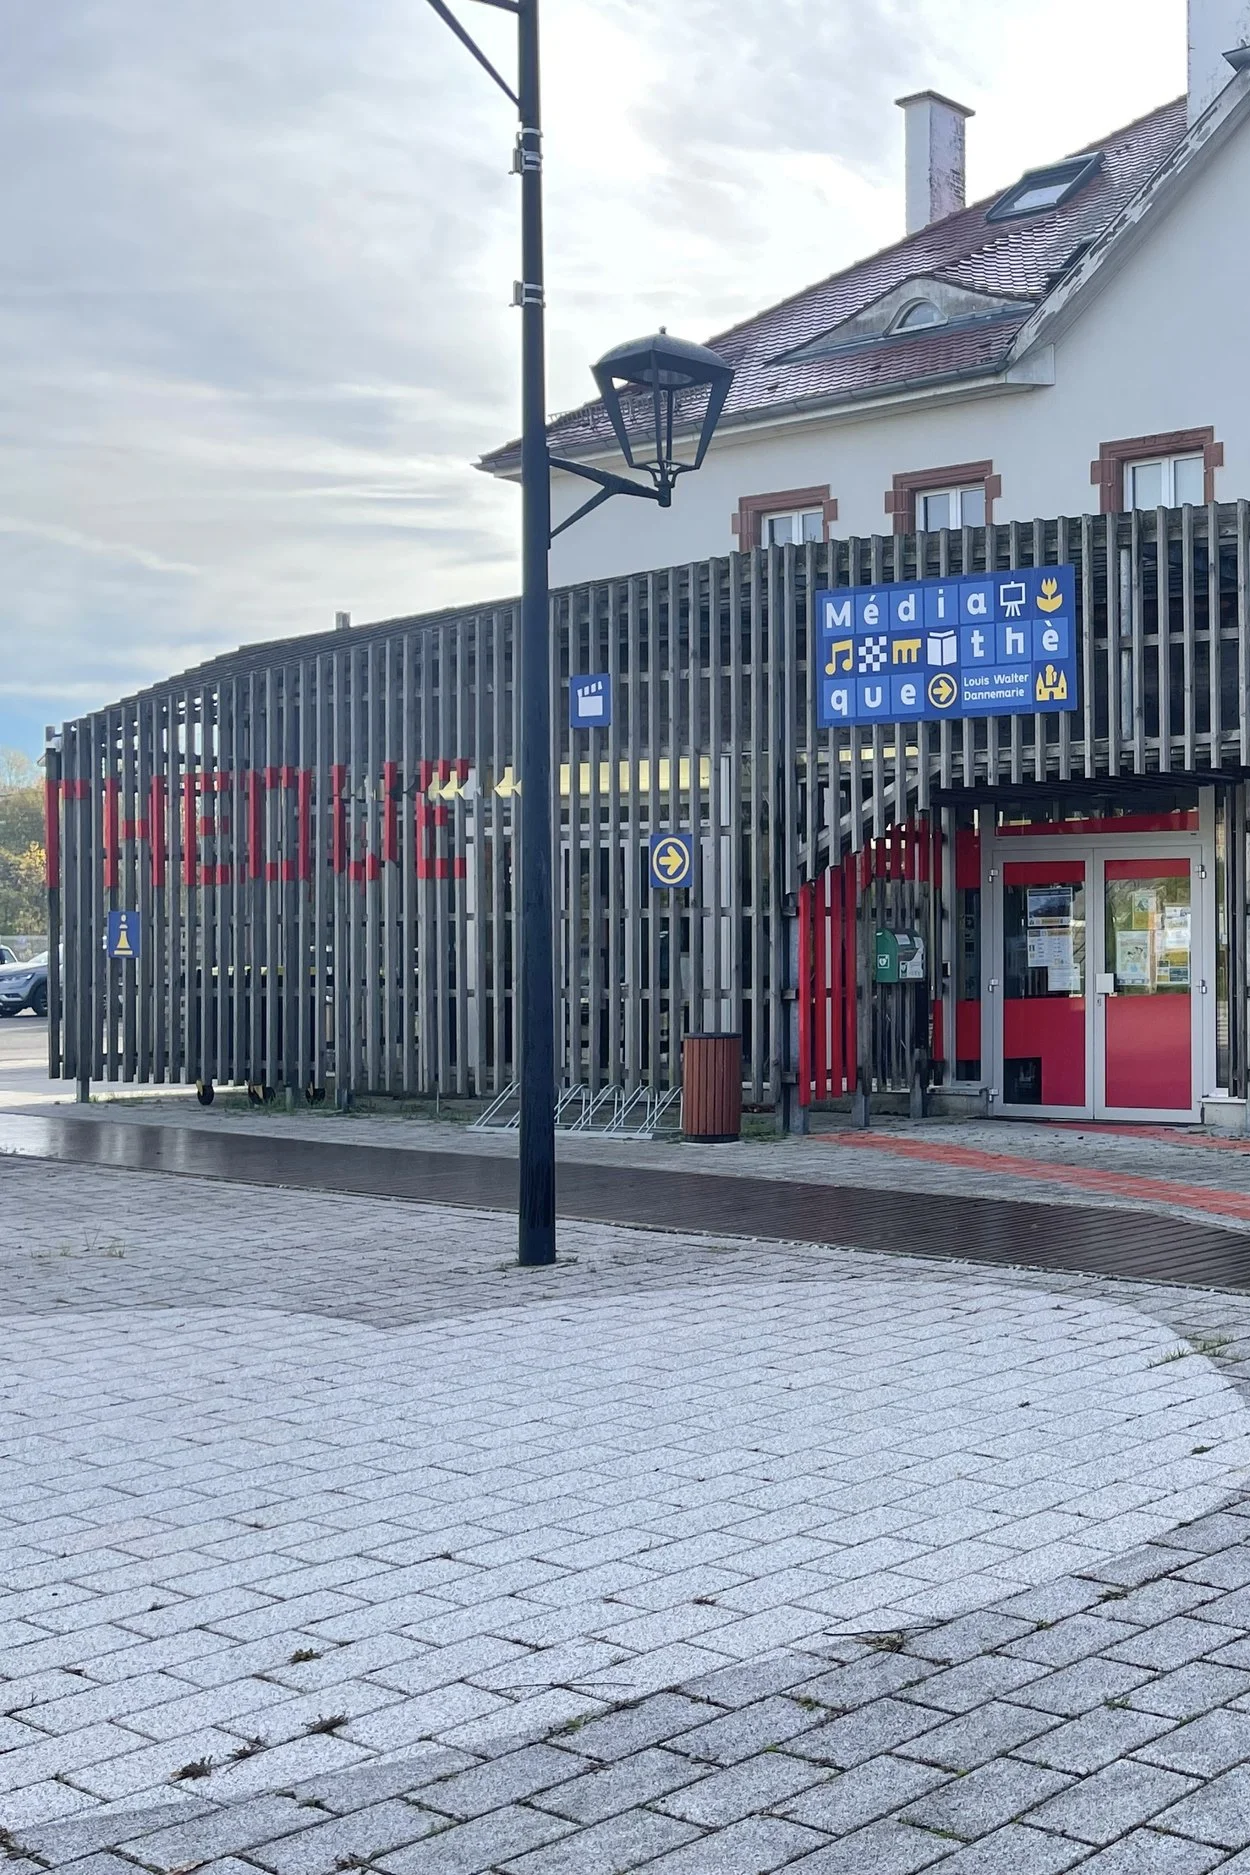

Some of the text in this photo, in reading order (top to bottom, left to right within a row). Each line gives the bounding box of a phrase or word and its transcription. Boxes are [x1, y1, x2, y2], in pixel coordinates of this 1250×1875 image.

[826, 588, 987, 629] Média
[970, 620, 1059, 658] thè
[963, 672, 1029, 687] Louis Walter
[964, 687, 1025, 701] Dannemarie
[831, 683, 917, 716] que
